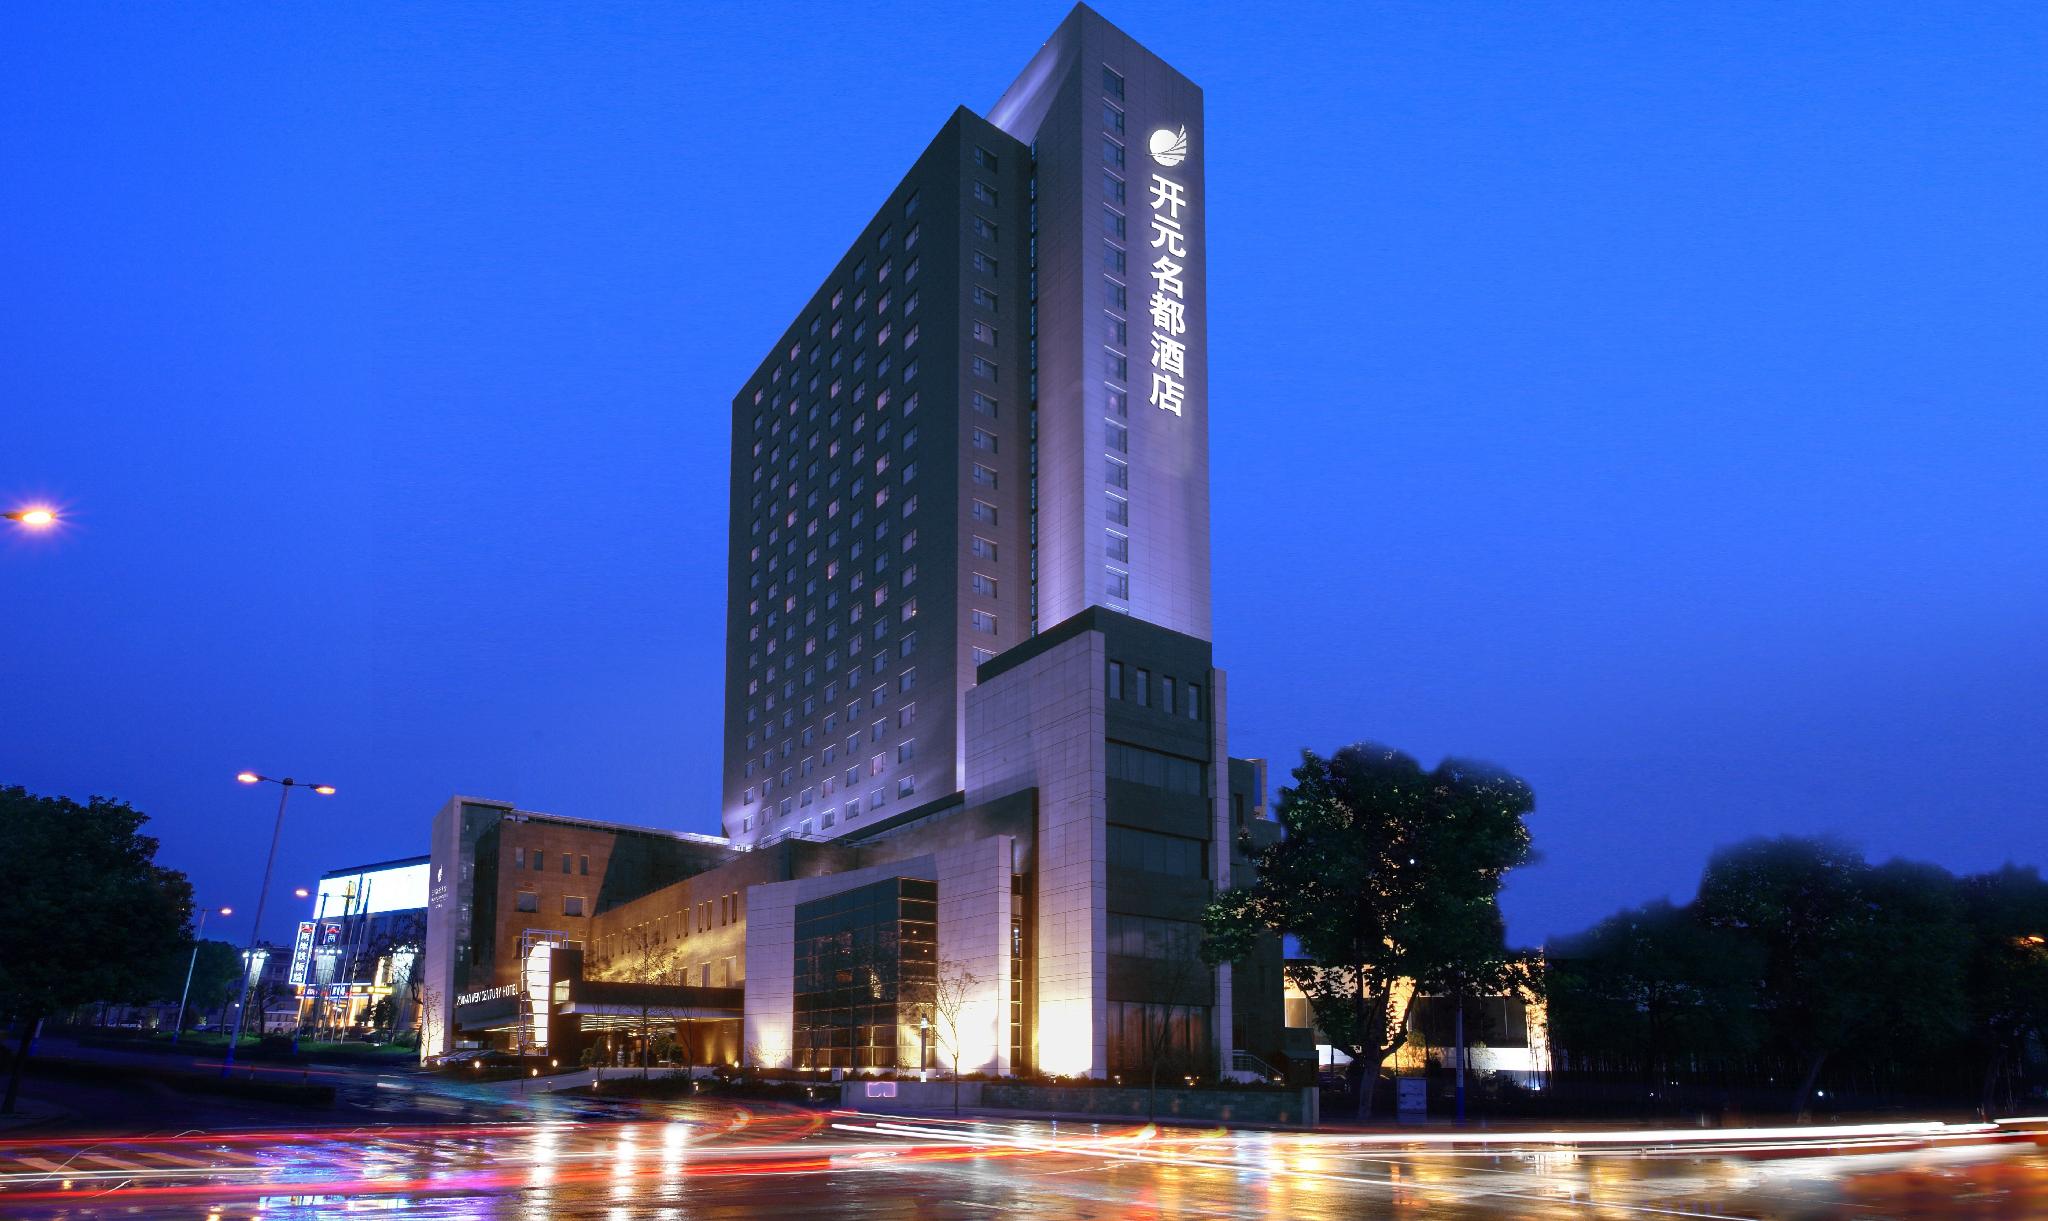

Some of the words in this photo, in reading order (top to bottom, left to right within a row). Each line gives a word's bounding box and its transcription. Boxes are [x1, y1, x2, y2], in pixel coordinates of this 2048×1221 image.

[1149, 174, 1186, 417] 开元名都酒店
[503, 983, 519, 997] HOTEL
